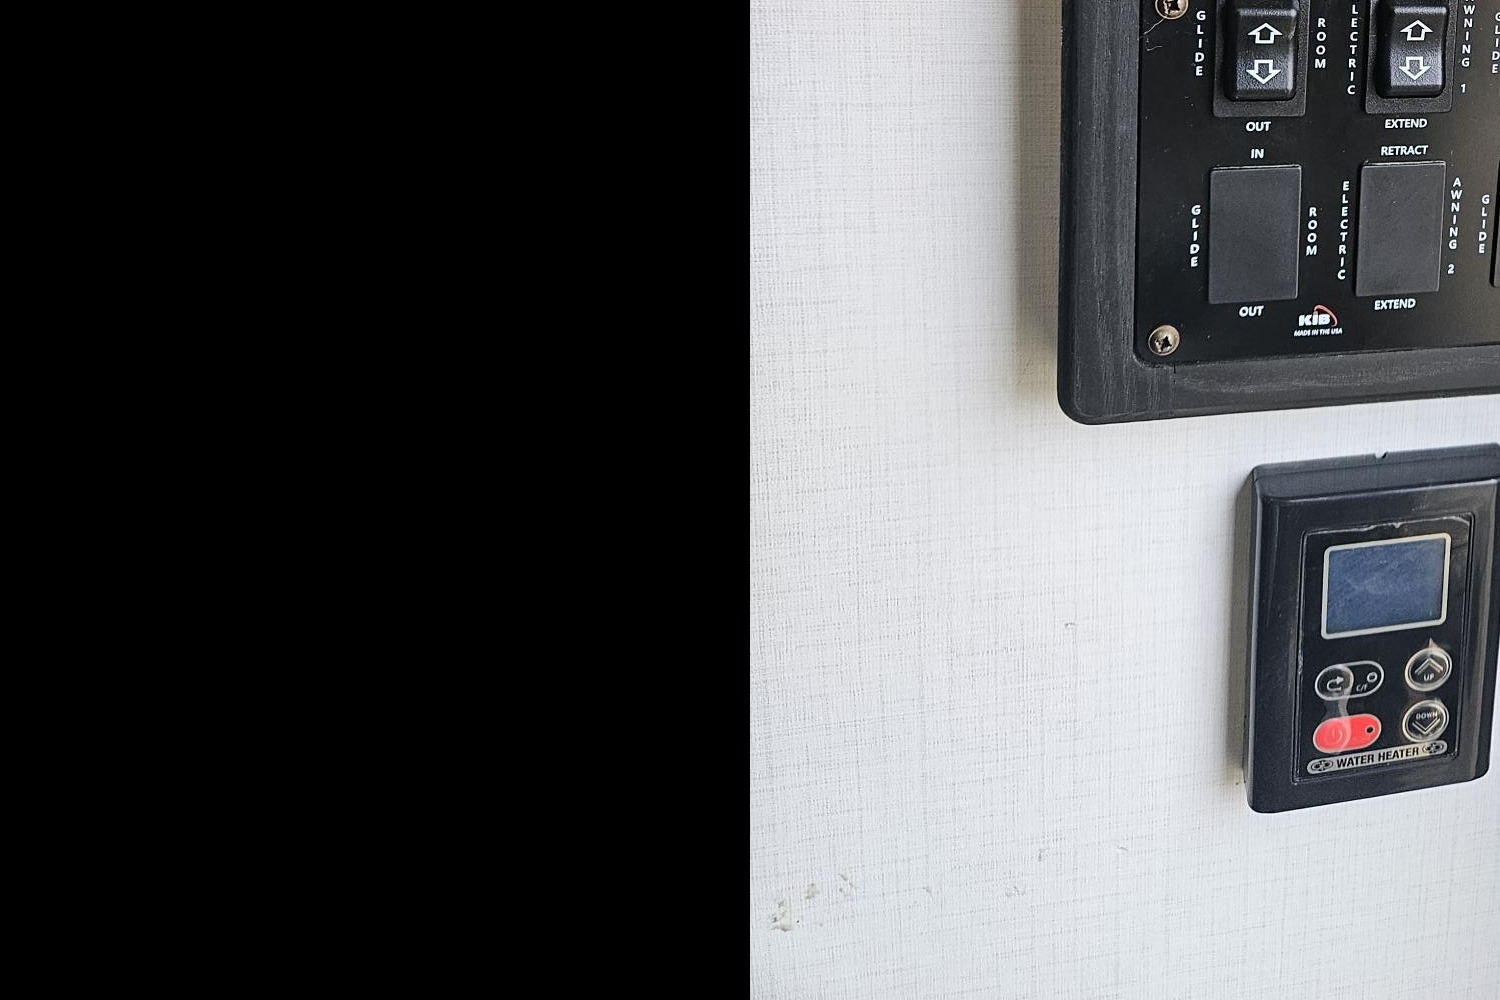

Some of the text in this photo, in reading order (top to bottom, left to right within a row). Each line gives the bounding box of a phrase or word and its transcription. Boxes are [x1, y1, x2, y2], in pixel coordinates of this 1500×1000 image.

[1460, 83, 1466, 93] 1
[1245, 121, 1271, 132] OUT
[1384, 118, 1428, 129] EXTEND
[1250, 148, 1265, 159] IN
[1380, 145, 1429, 156] RETRACT
[1447, 264, 1455, 275] 2
[1374, 298, 1417, 311] EXTEND
[1238, 305, 1264, 317] OUT
[1293, 327, 1343, 337] MADE IN THE USA
[1416, 711, 1438, 720] DOWN
[1336, 747, 1419, 768] WATER HEATER
